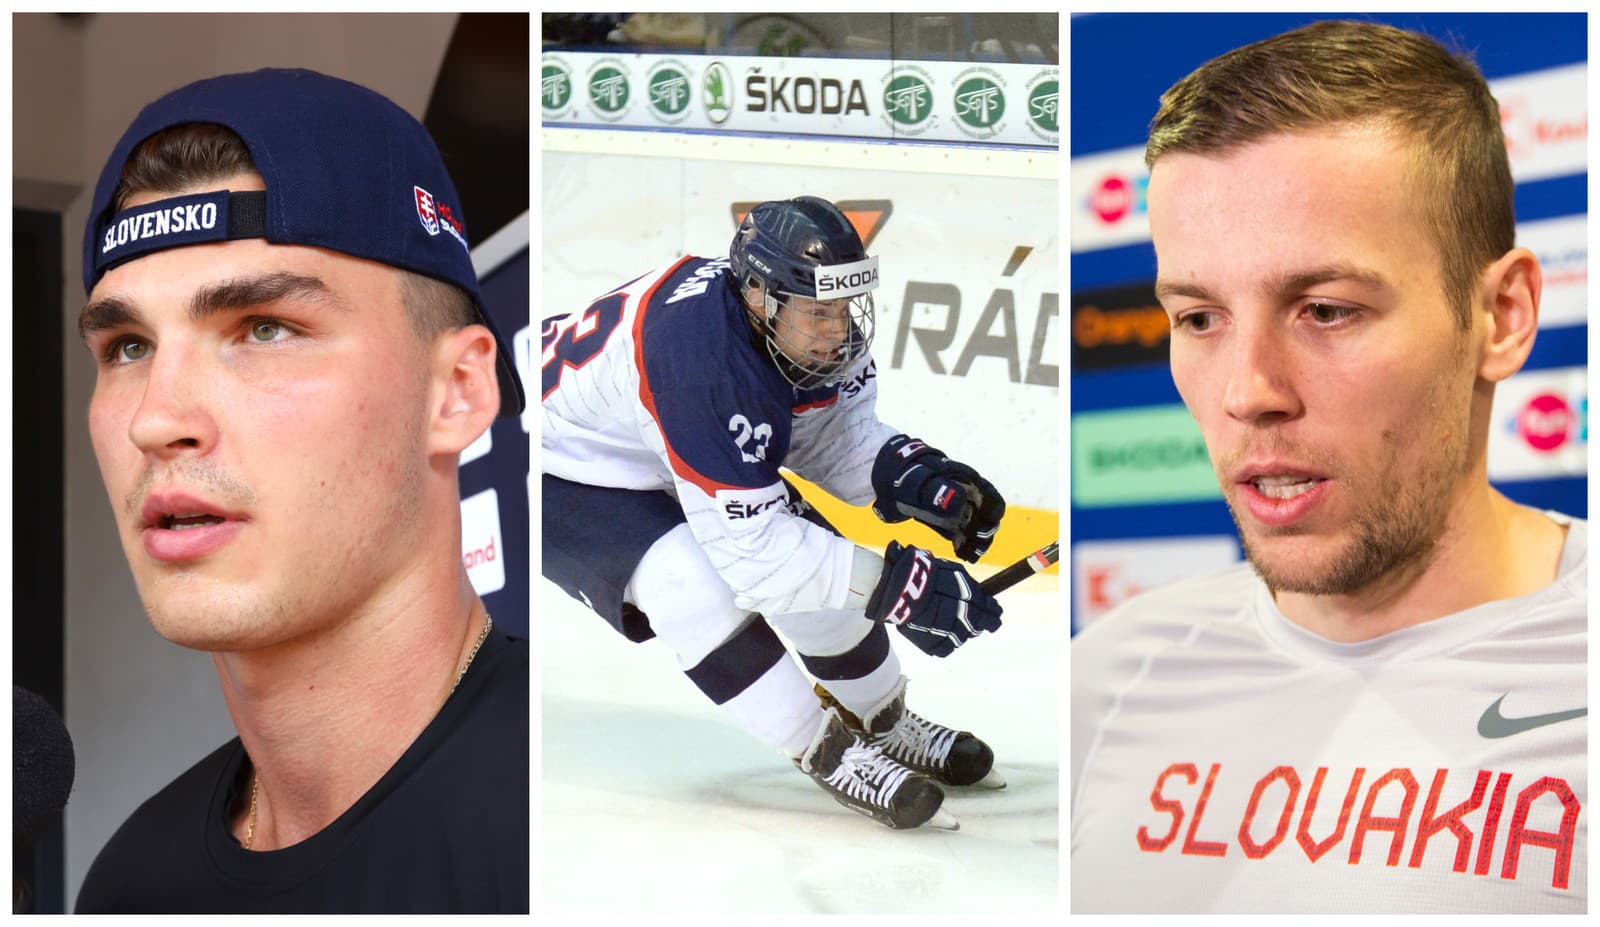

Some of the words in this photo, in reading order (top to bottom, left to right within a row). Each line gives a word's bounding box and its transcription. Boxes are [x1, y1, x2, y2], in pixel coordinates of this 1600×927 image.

[746, 67, 870, 117] ŠKODA
[102, 202, 217, 254] SLOVENSKO
[747, 254, 772, 274] CCM
[818, 267, 879, 292] ŠKODA
[728, 413, 773, 463] 23
[1136, 762, 1581, 890] SLOVAKIA
